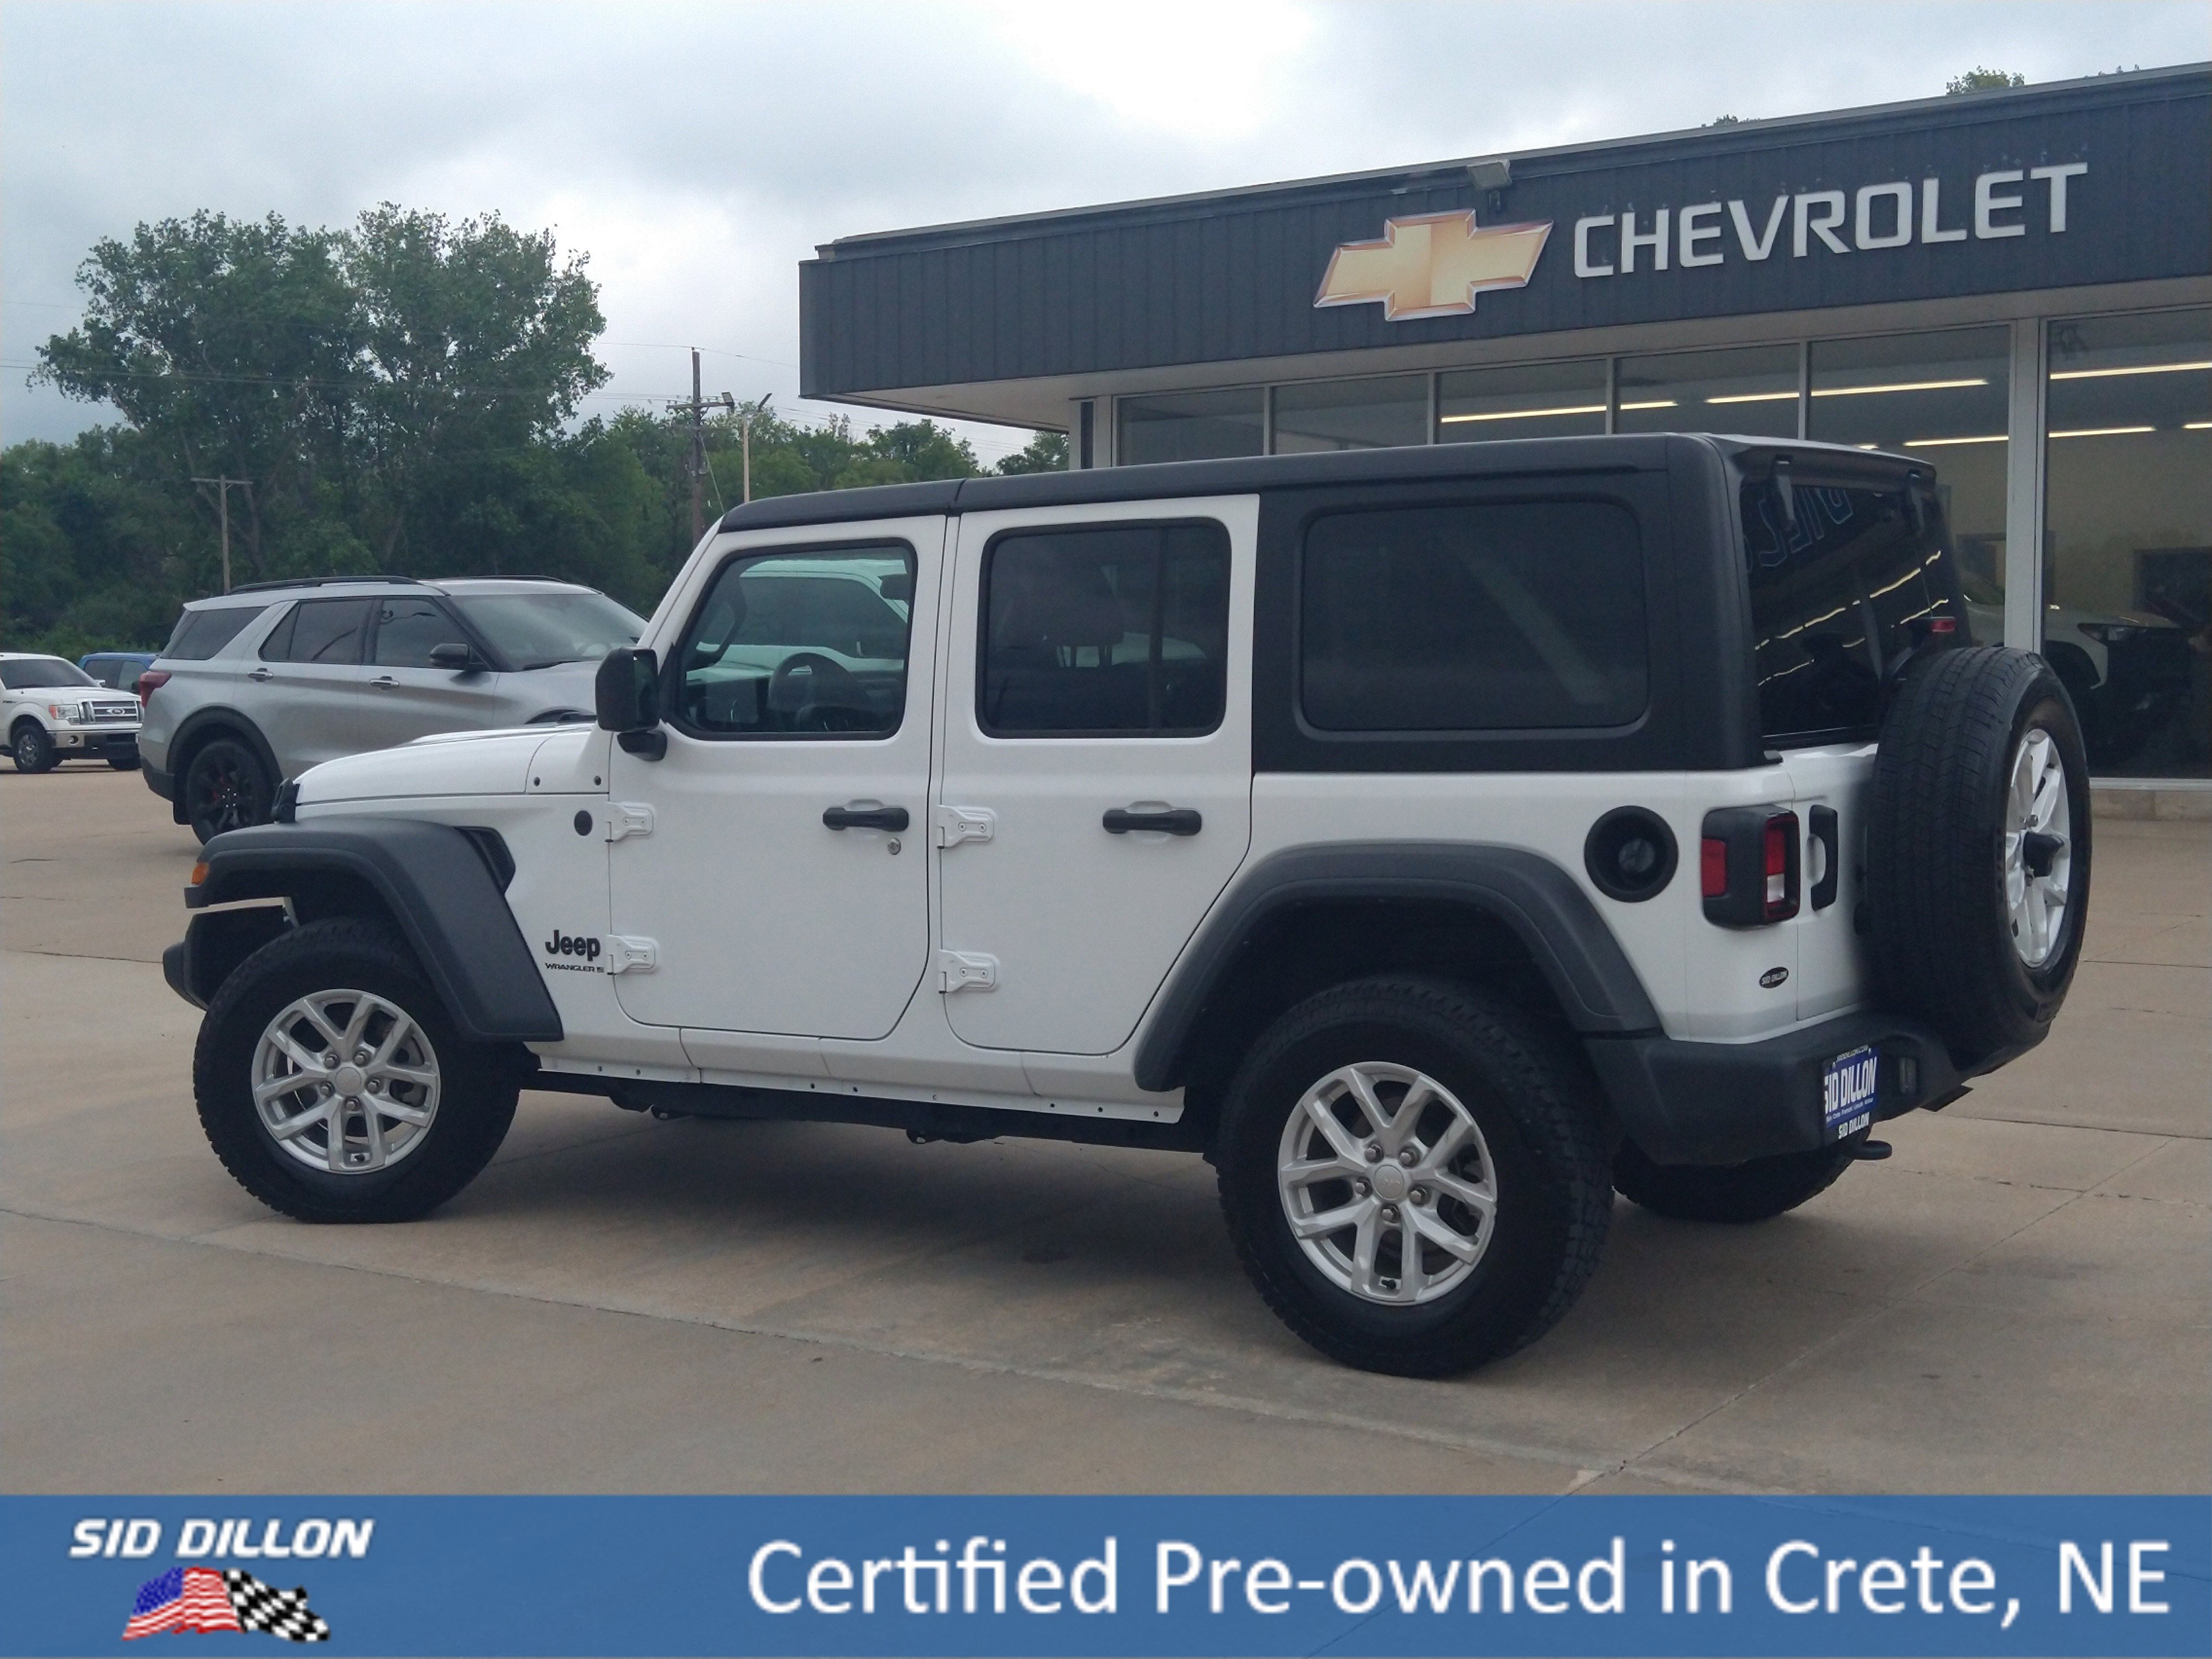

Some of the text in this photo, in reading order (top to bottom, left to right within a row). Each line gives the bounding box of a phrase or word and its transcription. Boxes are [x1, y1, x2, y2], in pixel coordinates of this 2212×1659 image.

[1574, 163, 2088, 278] CHEVROLET
[545, 929, 601, 962] Jeep
[545, 962, 594, 972] WRANGLER
[1824, 1072, 1839, 1115] SID
[1841, 1056, 1878, 1107] DILLON
[1838, 1112, 1870, 1140] SID DILLON
